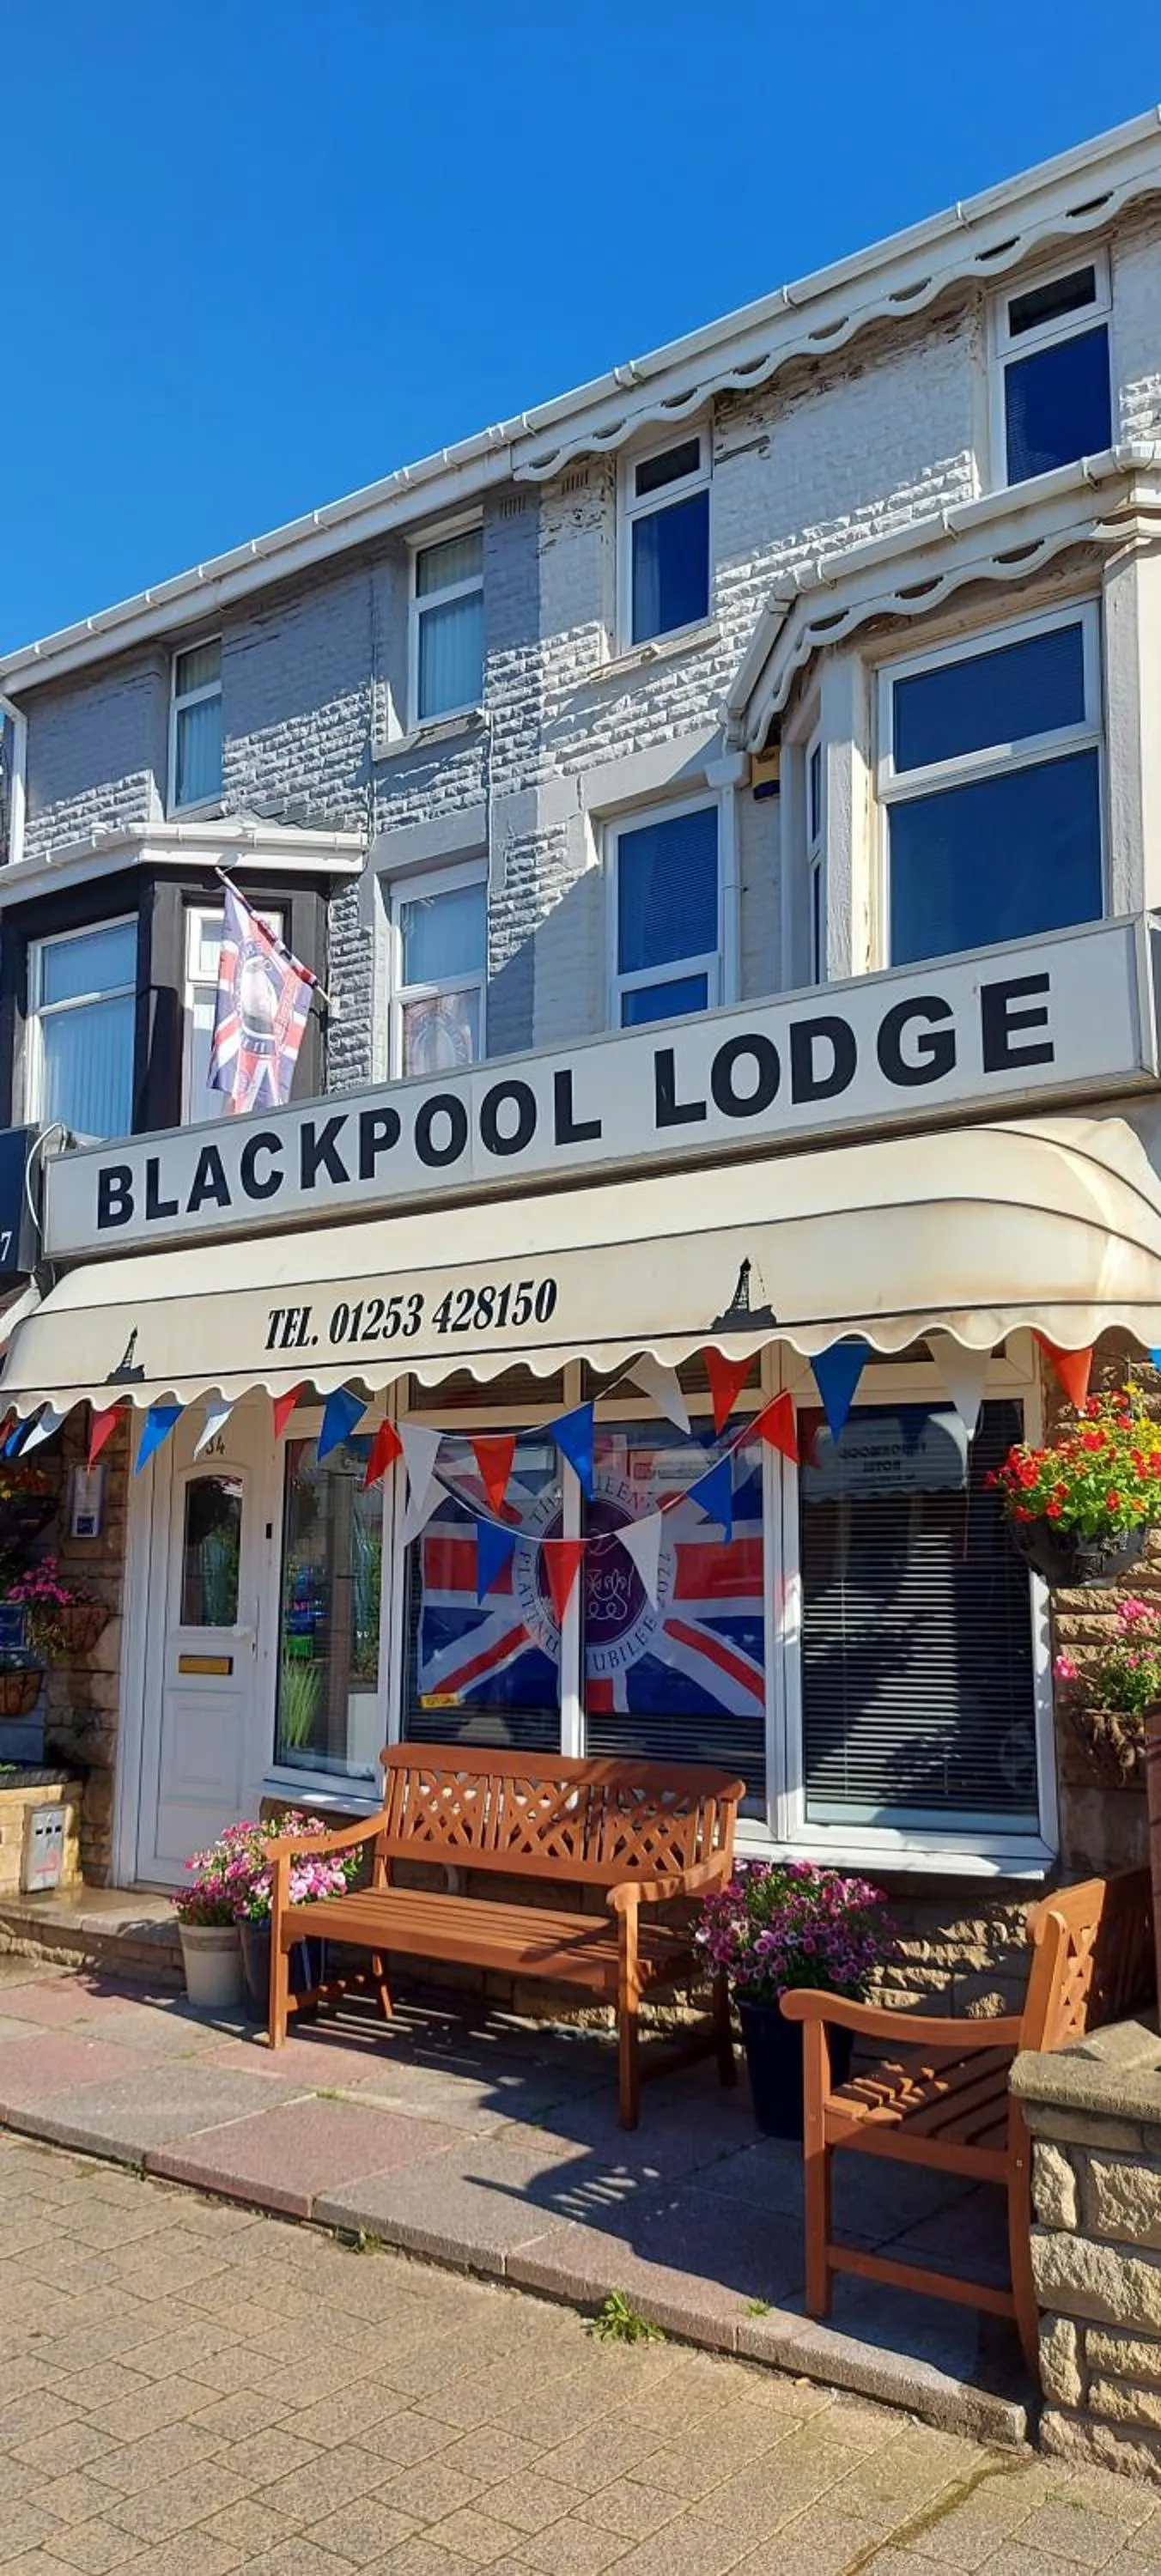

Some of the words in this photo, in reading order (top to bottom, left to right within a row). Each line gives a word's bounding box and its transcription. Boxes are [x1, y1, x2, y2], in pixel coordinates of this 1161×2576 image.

[97, 1069, 602, 1230] BLACKPOOL
[654, 972, 1055, 1129] LODGE
[264, 1306, 319, 1350] TEL.
[329, 1293, 424, 1344] 01253
[431, 1278, 557, 1334] 428150
[206, 1436, 226, 1455] 34
[517, 1551, 559, 1655] PLATINU
[593, 1615, 658, 1672] UBILEE
